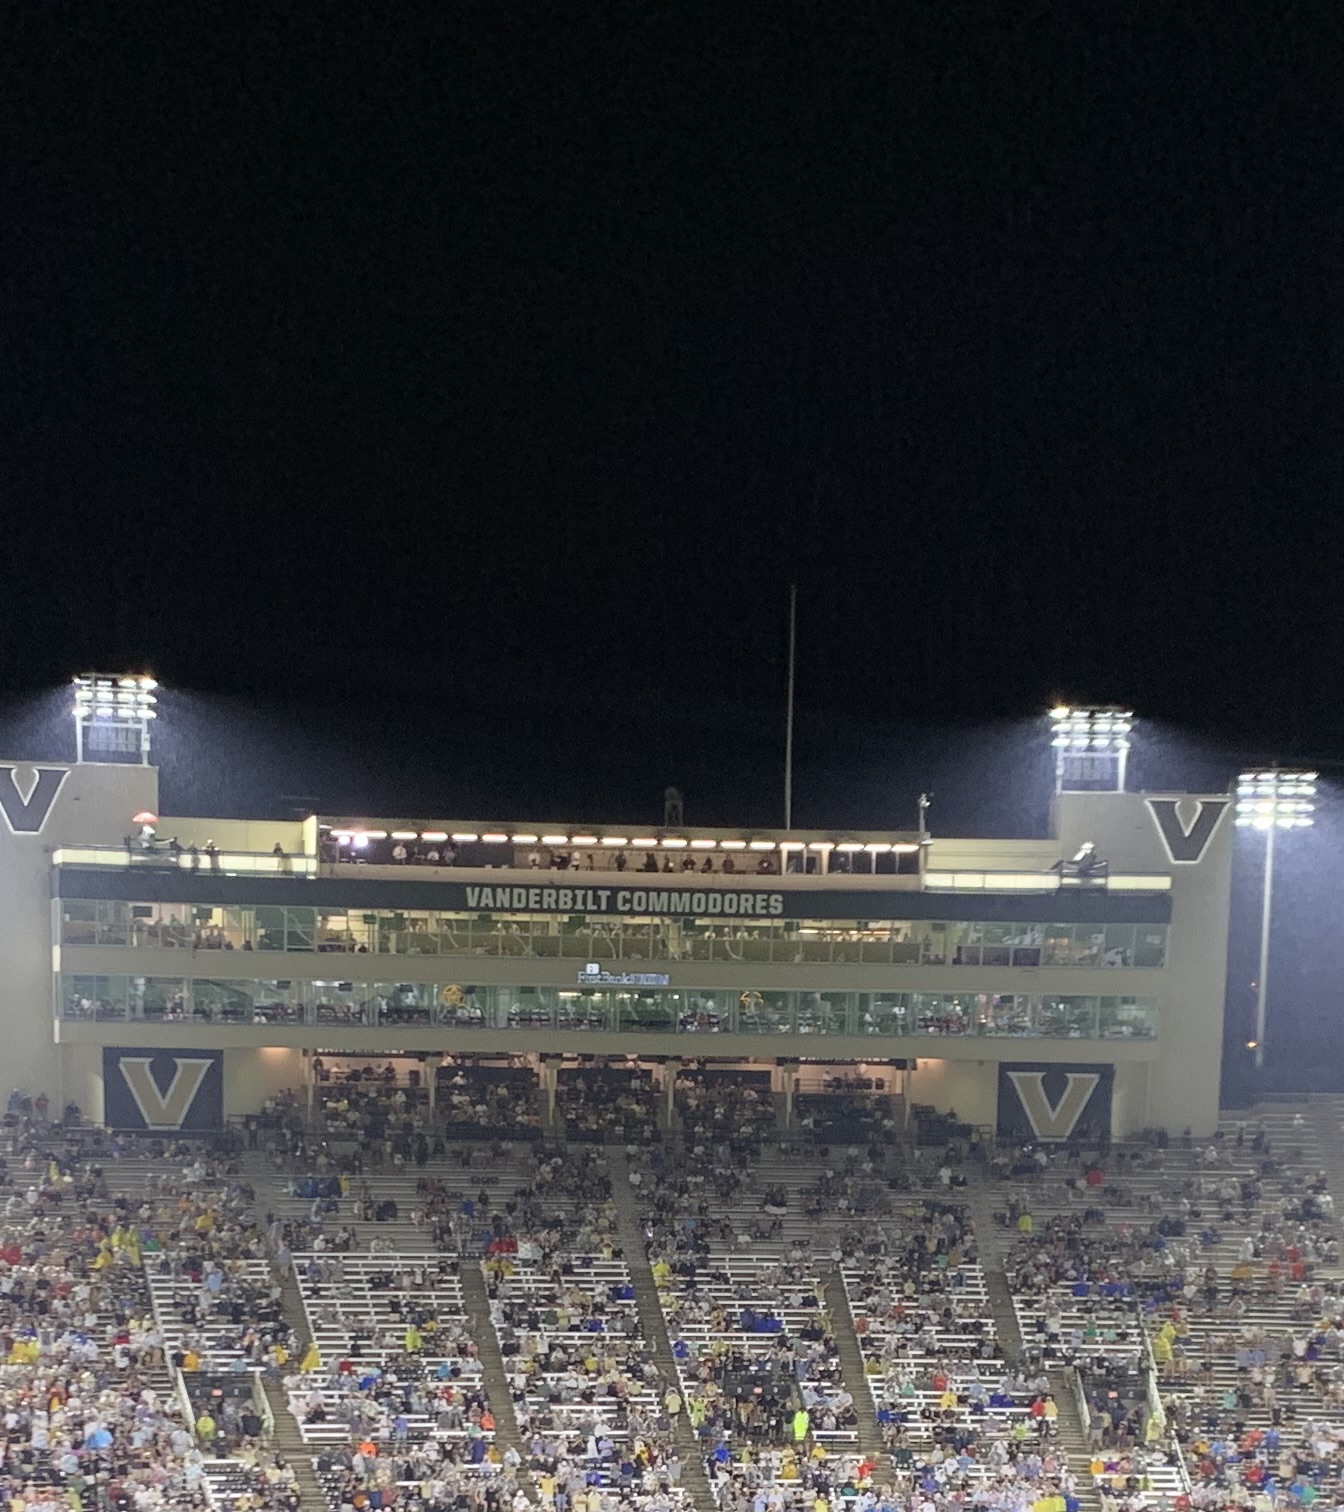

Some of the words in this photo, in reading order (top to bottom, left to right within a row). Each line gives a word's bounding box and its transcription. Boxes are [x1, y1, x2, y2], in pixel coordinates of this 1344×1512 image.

[1145, 797, 1231, 865] V
[466, 886, 611, 911] VANDERBILT
[617, 891, 783, 915] COMMODORES
[118, 1057, 215, 1130] V
[1009, 1070, 1100, 1142] V
